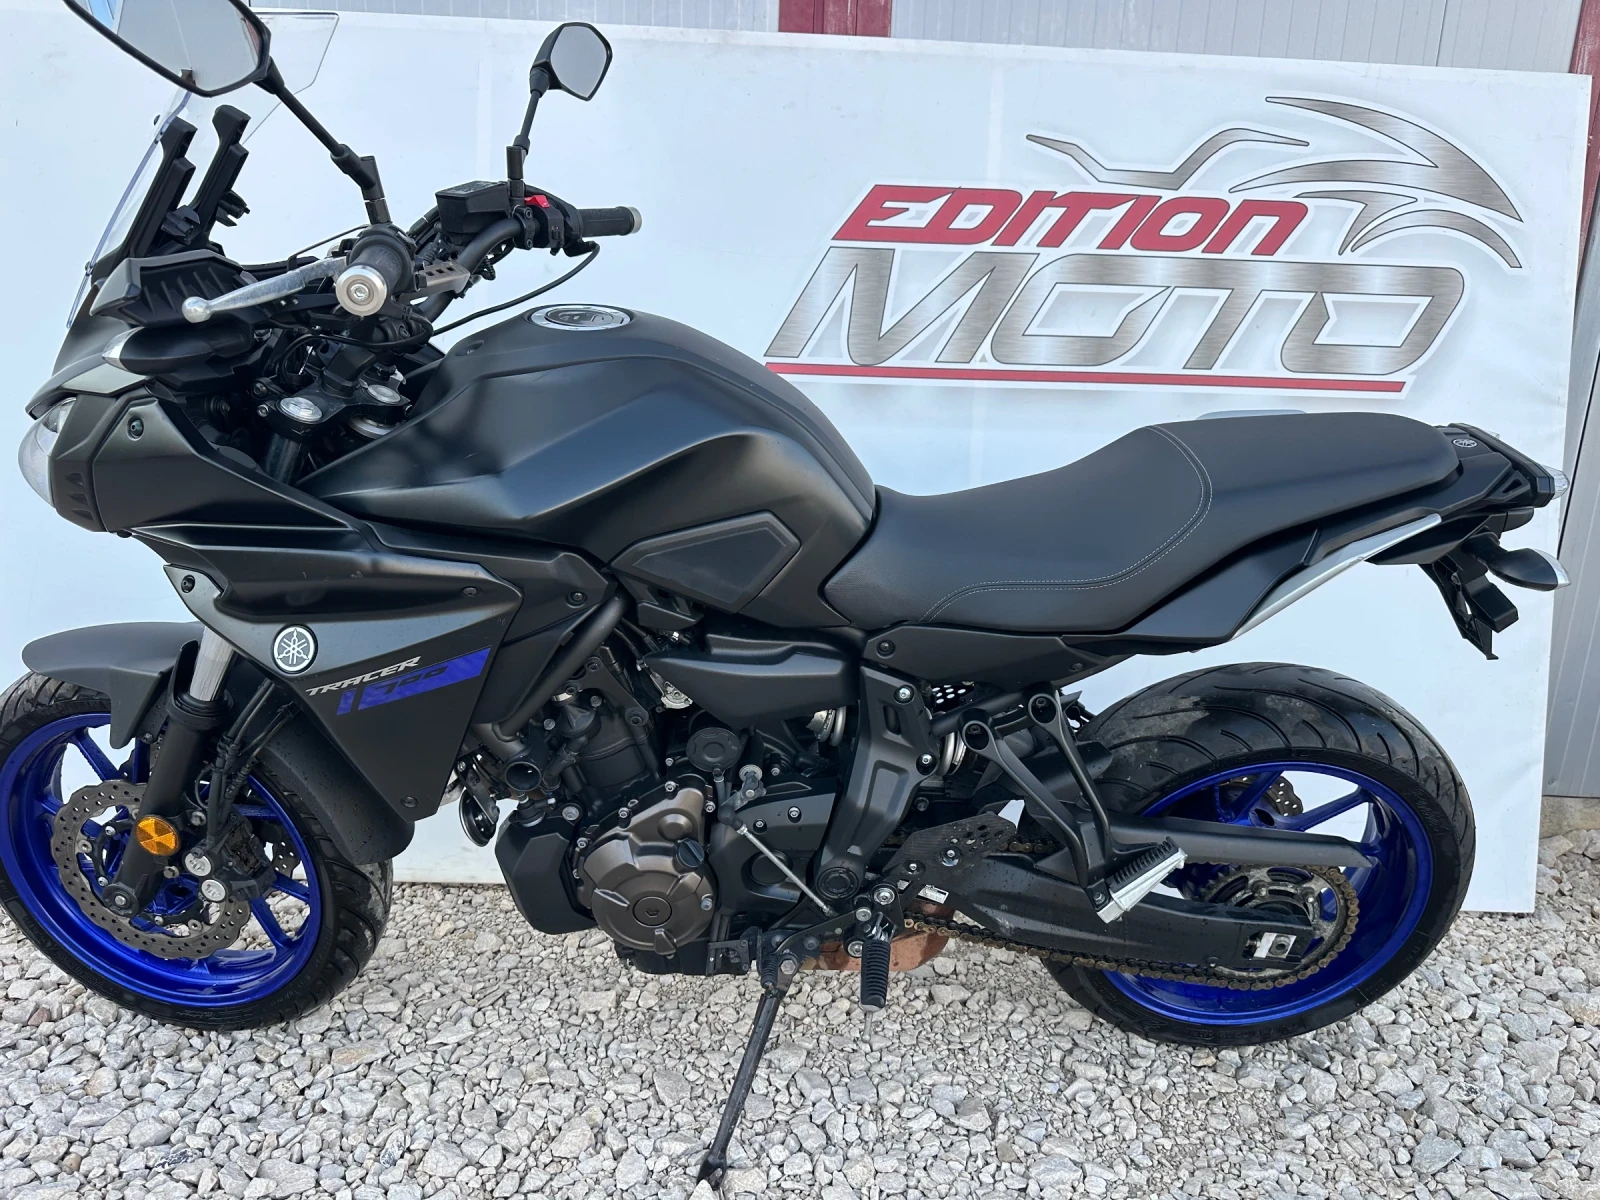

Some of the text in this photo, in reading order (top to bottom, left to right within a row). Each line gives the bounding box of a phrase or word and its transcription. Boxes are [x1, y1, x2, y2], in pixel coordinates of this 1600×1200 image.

[830, 184, 1308, 256] EDITION
[764, 246, 1465, 375] MOTO
[305, 655, 422, 697] TRACER
